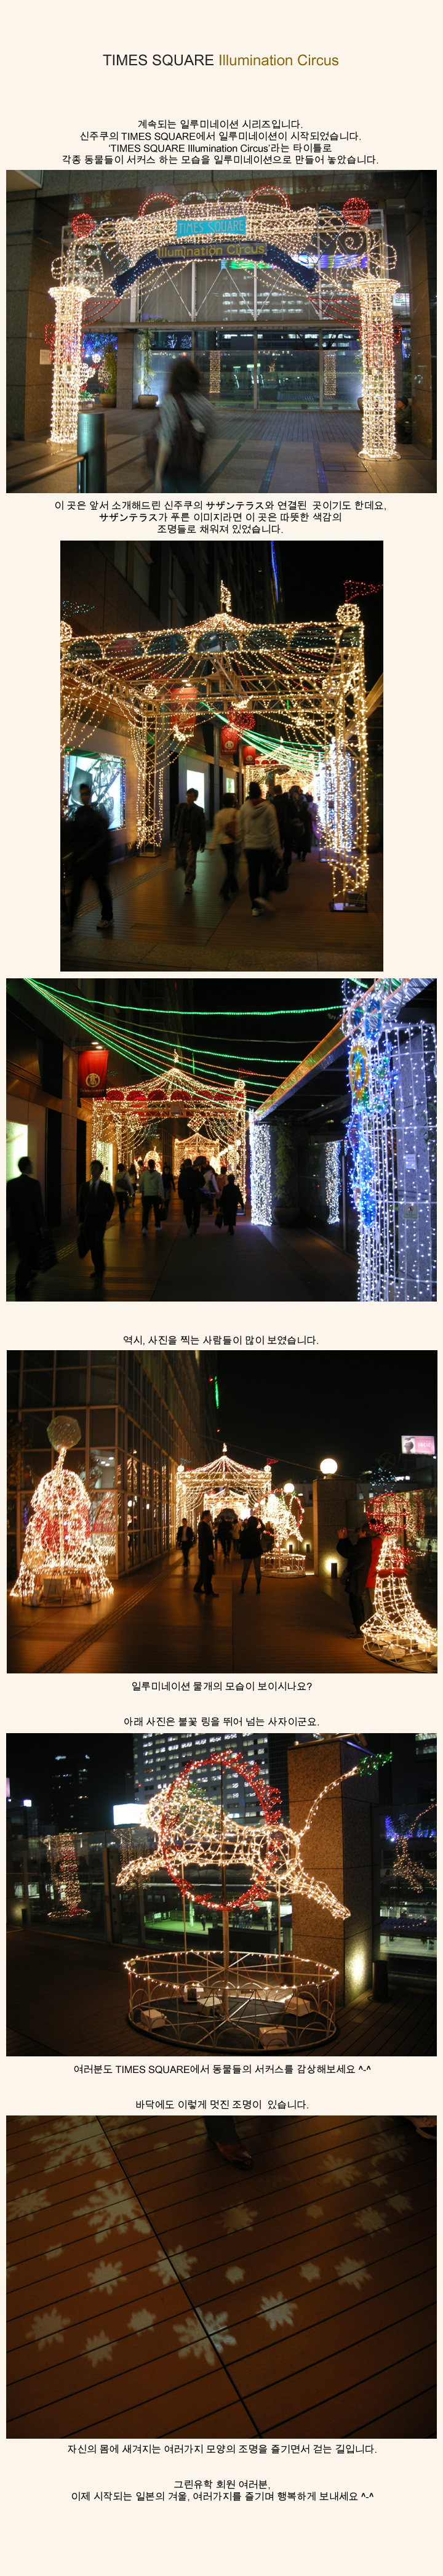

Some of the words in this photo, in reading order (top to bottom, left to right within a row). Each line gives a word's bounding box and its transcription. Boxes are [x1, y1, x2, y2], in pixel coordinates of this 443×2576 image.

[178, 222, 204, 234] TIMES
[206, 219, 244, 238] SQUARE
[158, 246, 223, 257] Illumination
[226, 244, 265, 254] Circus
